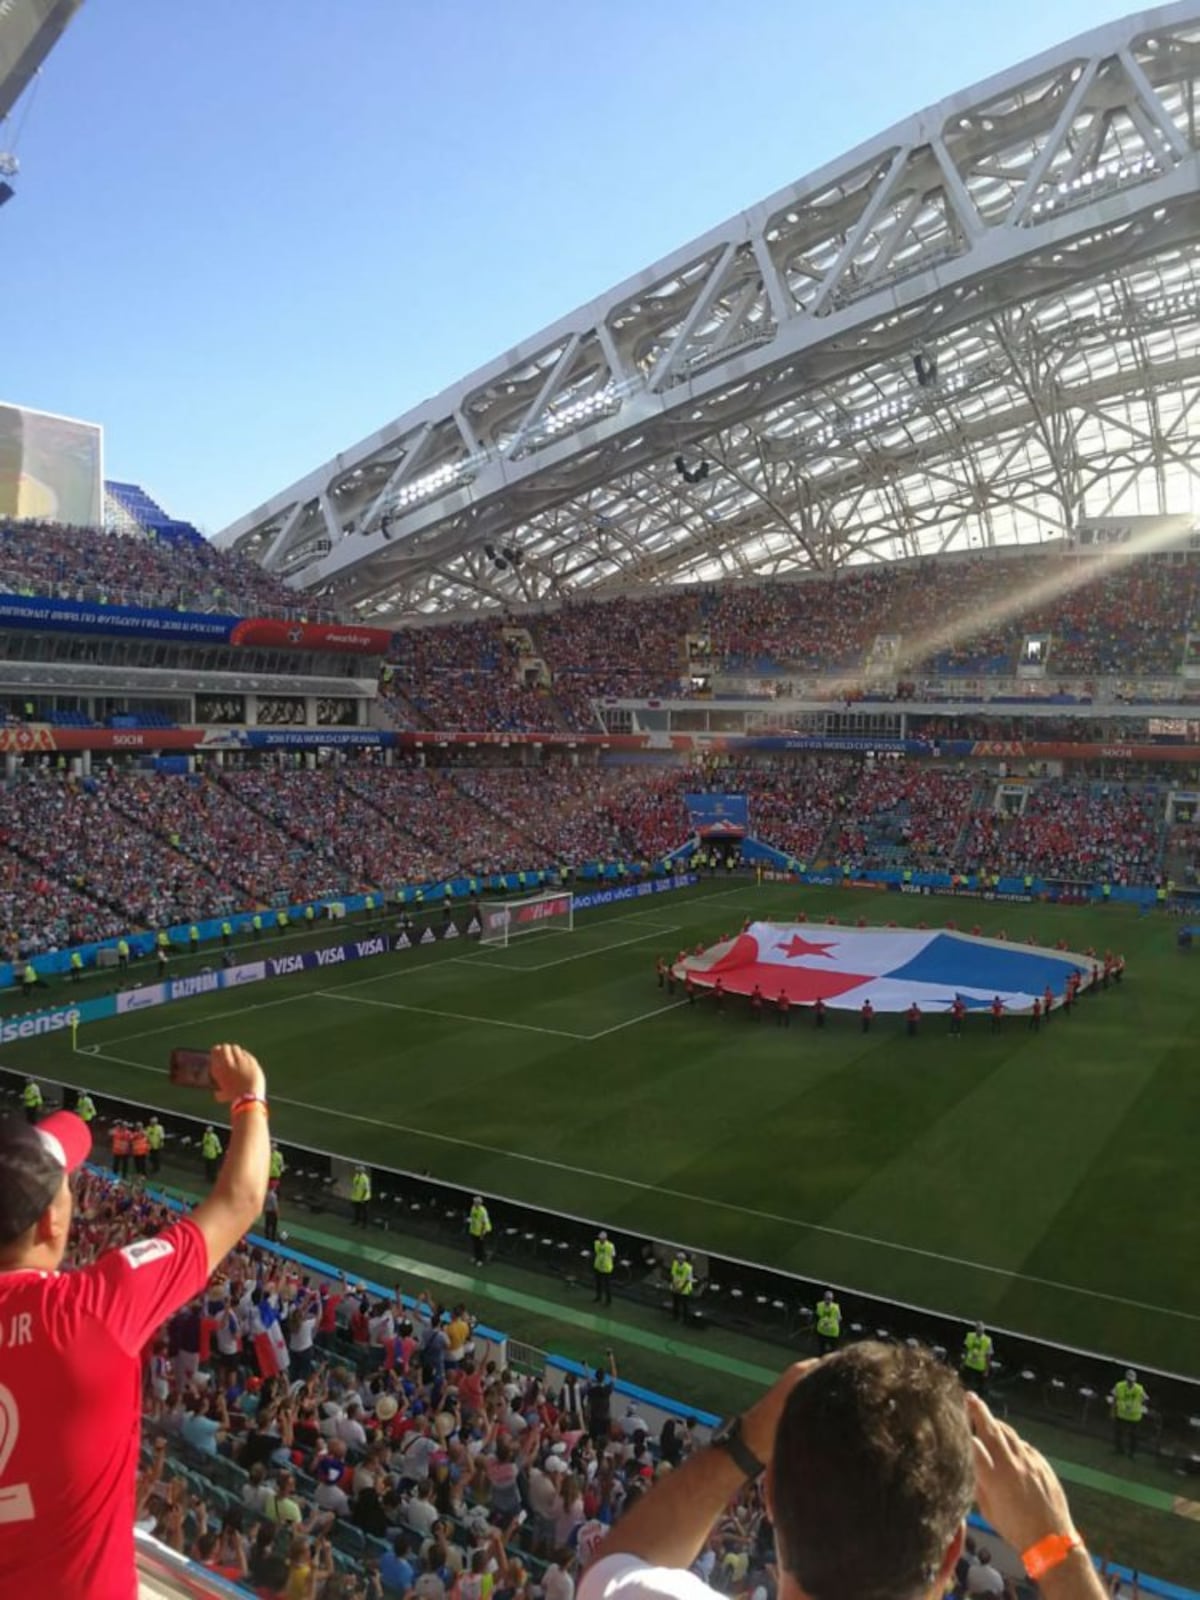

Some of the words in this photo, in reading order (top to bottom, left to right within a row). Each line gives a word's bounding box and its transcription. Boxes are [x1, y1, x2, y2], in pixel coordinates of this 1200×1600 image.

[901, 884, 921, 893] VISA
[314, 946, 345, 966] VISA
[356, 938, 384, 957] VISA
[272, 954, 304, 975] VISA
[7, 1312, 33, 1348] JR
